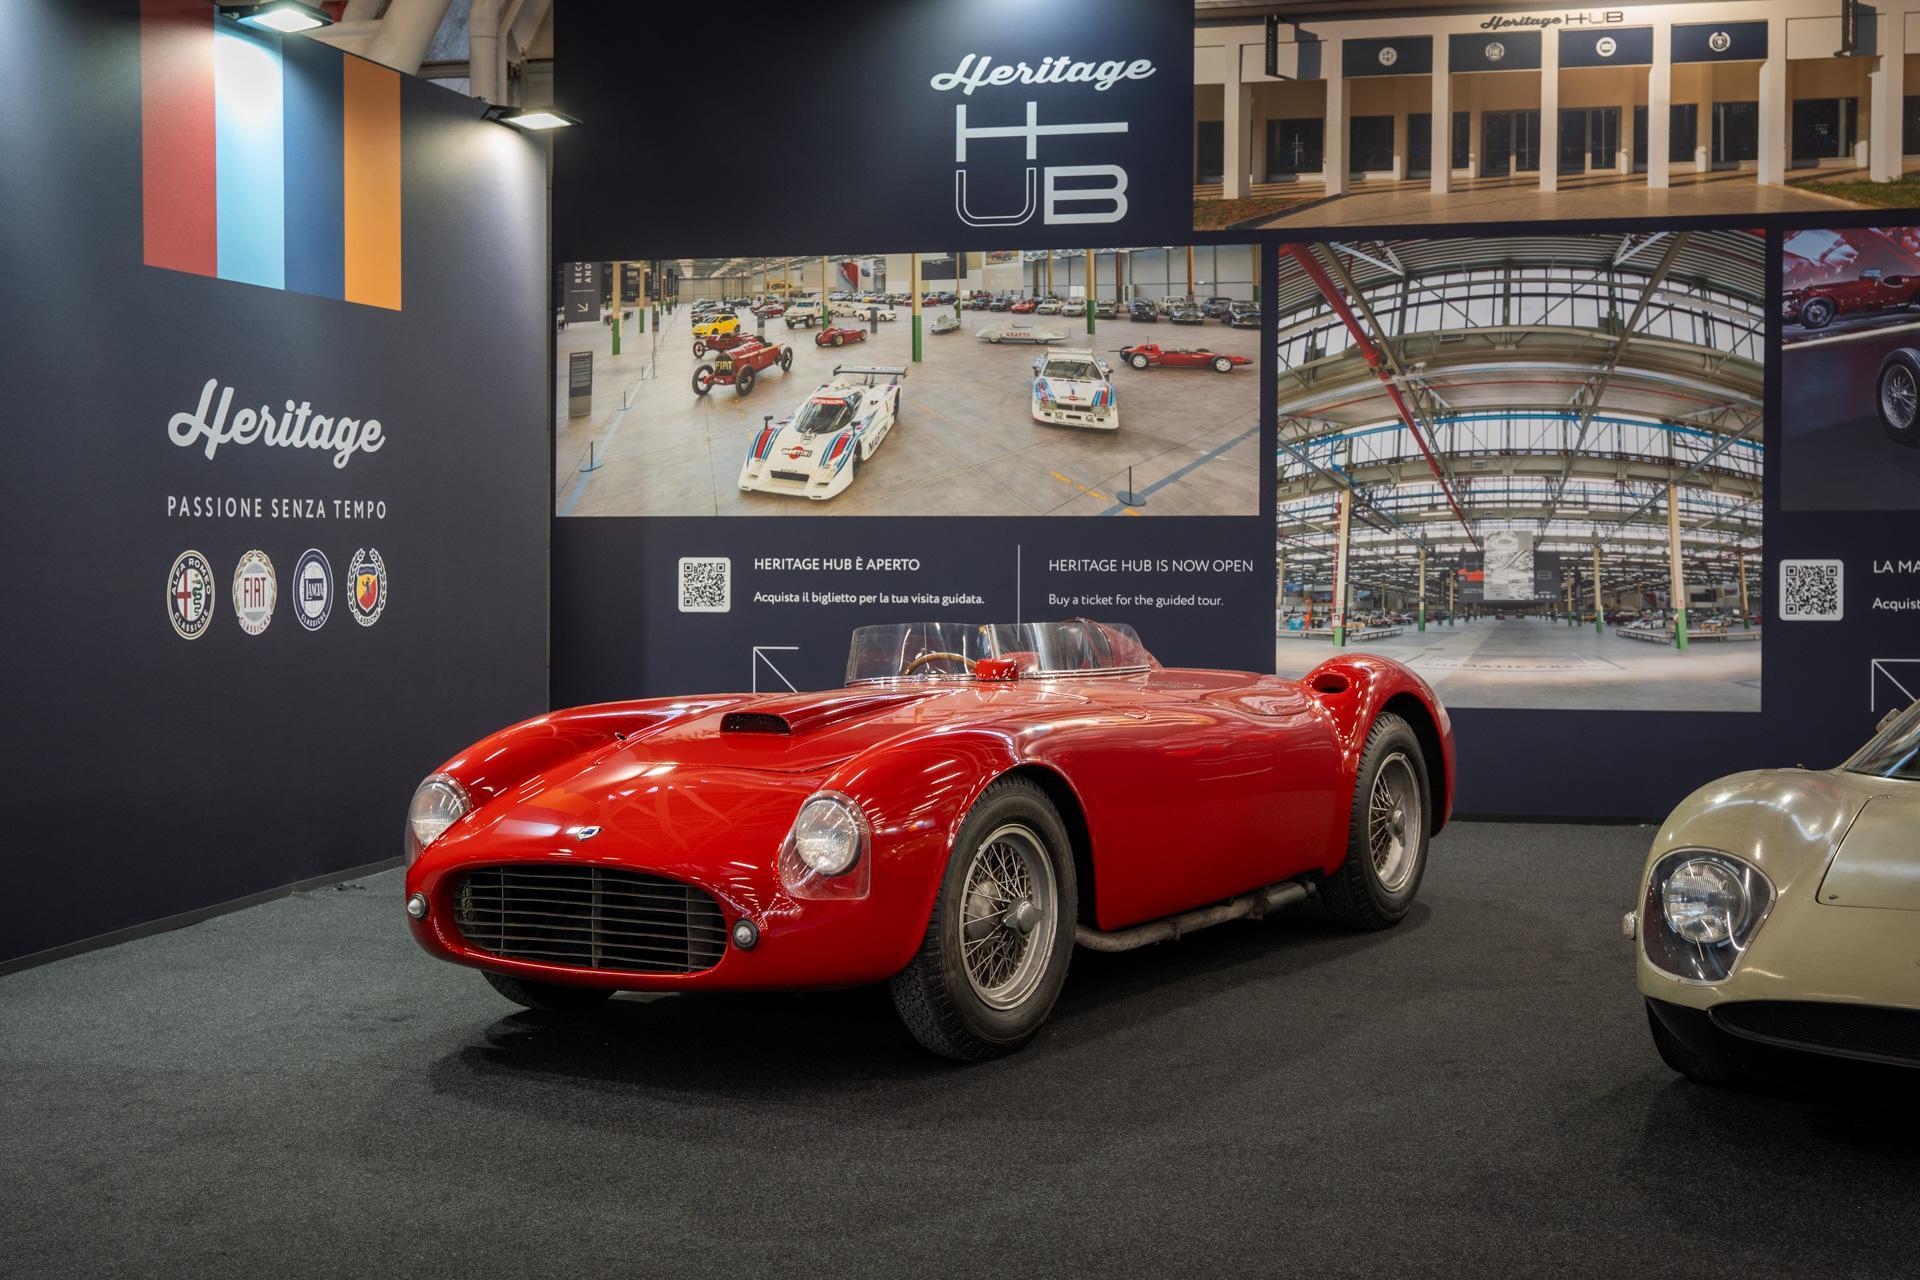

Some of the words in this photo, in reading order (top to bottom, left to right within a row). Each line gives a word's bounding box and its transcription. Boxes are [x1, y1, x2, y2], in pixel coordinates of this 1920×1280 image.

[1480, 16, 1562, 30] Heritage
[1565, 12, 1624, 25] HUB
[930, 53, 1157, 96] Heritage
[584, 263, 593, 284] AND
[715, 360, 733, 370] FIAT
[167, 378, 386, 469] Heritage
[167, 496, 263, 518] PASSIONE
[271, 498, 326, 519] SENZA
[332, 500, 387, 520] TEMPO
[754, 557, 820, 571] HERITAGE
[823, 558, 853, 571] HUB
[855, 555, 864, 571] È
[865, 558, 921, 571] APERTO
[1048, 559, 1118, 572] HERITAGE
[1121, 559, 1153, 572] HUB
[1156, 559, 1169, 572] IS
[1172, 559, 1210, 572] NOW
[1212, 559, 1254, 572] OPEN
[1873, 560, 1894, 574] LA
[171, 562, 186, 596] ALFA
[188, 558, 211, 596] ROMEO
[244, 577, 266, 609] FIAT
[305, 580, 325, 600] LANCIA
[753, 591, 800, 605] Acquista
[802, 591, 810, 603] il
[811, 591, 858, 606] biglietto
[858, 594, 878, 606] per
[879, 592, 890, 604] la
[891, 593, 909, 604] tua
[910, 592, 940, 604] visita
[941, 593, 985, 607] guidata.
[1048, 593, 1071, 608] Buy
[1072, 596, 1079, 605] a
[1081, 594, 1113, 606] ticket
[1115, 594, 1133, 606] for
[1134, 594, 1154, 606] the
[1155, 594, 1195, 609] guided
[1197, 595, 1224, 606] tour.
[174, 609, 209, 633] CLASSICHE
